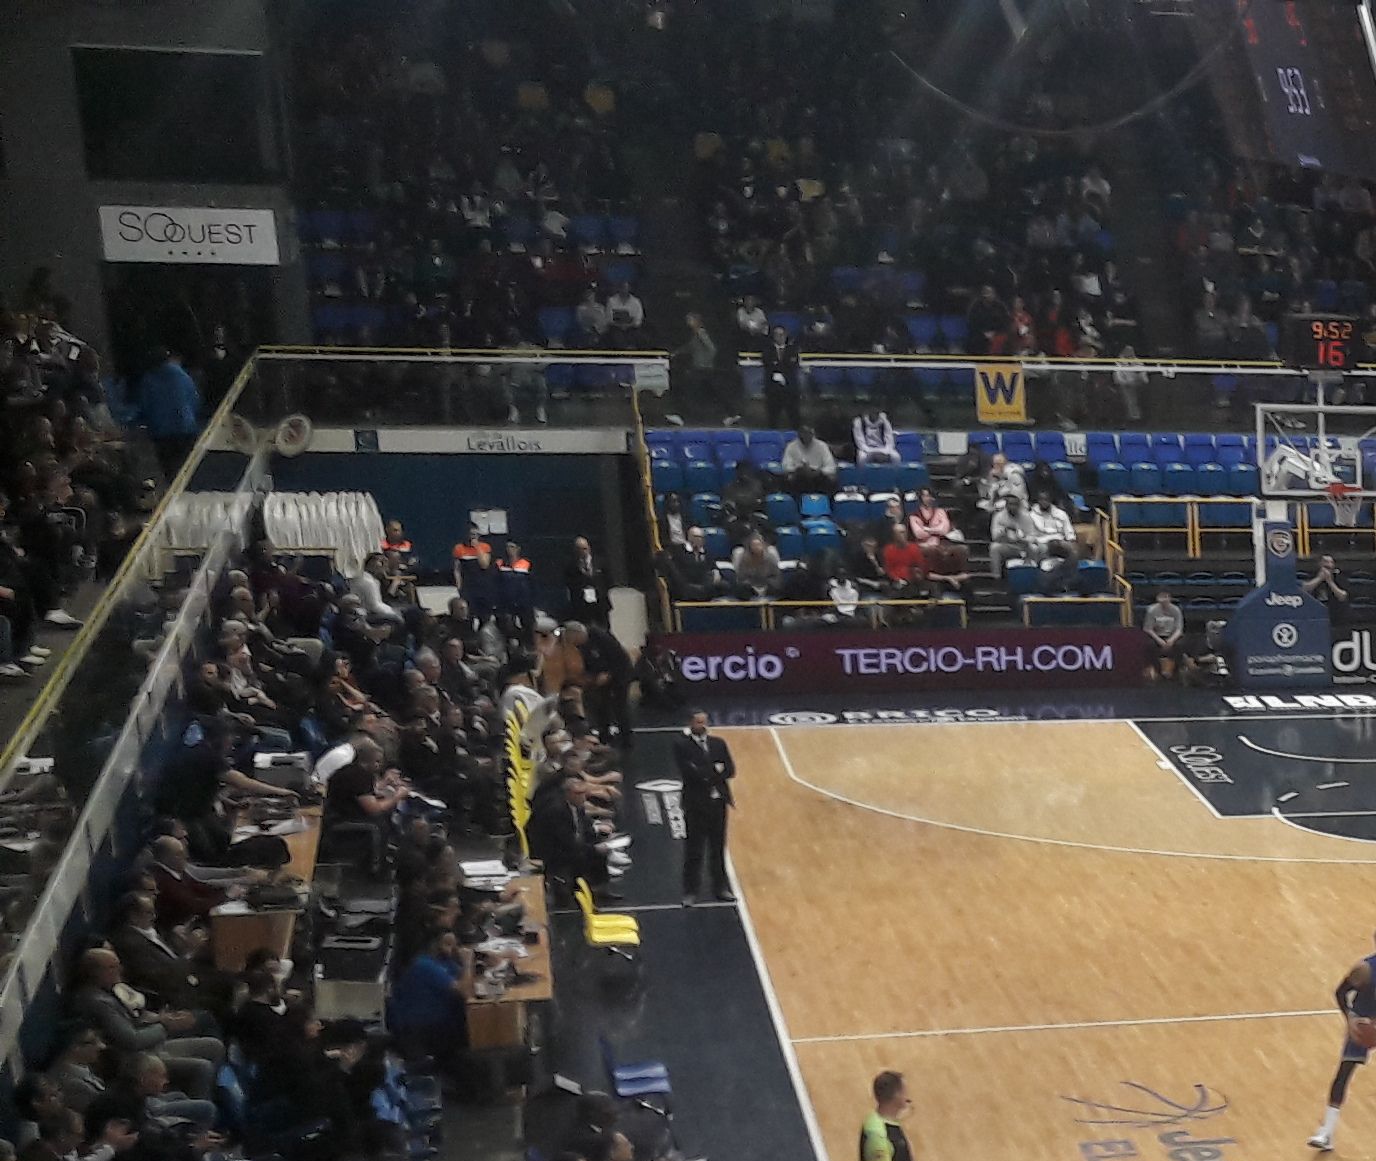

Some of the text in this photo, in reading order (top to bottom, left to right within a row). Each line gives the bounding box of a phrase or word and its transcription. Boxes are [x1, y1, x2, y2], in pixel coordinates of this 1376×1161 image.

[1318, 341, 1345, 367] 16
[979, 371, 1020, 405] W
[467, 435, 542, 454] Levallois
[1265, 592, 1304, 608] Jeep
[677, 646, 783, 681] ercio
[835, 645, 1113, 675] TERCIO-RH.COM
